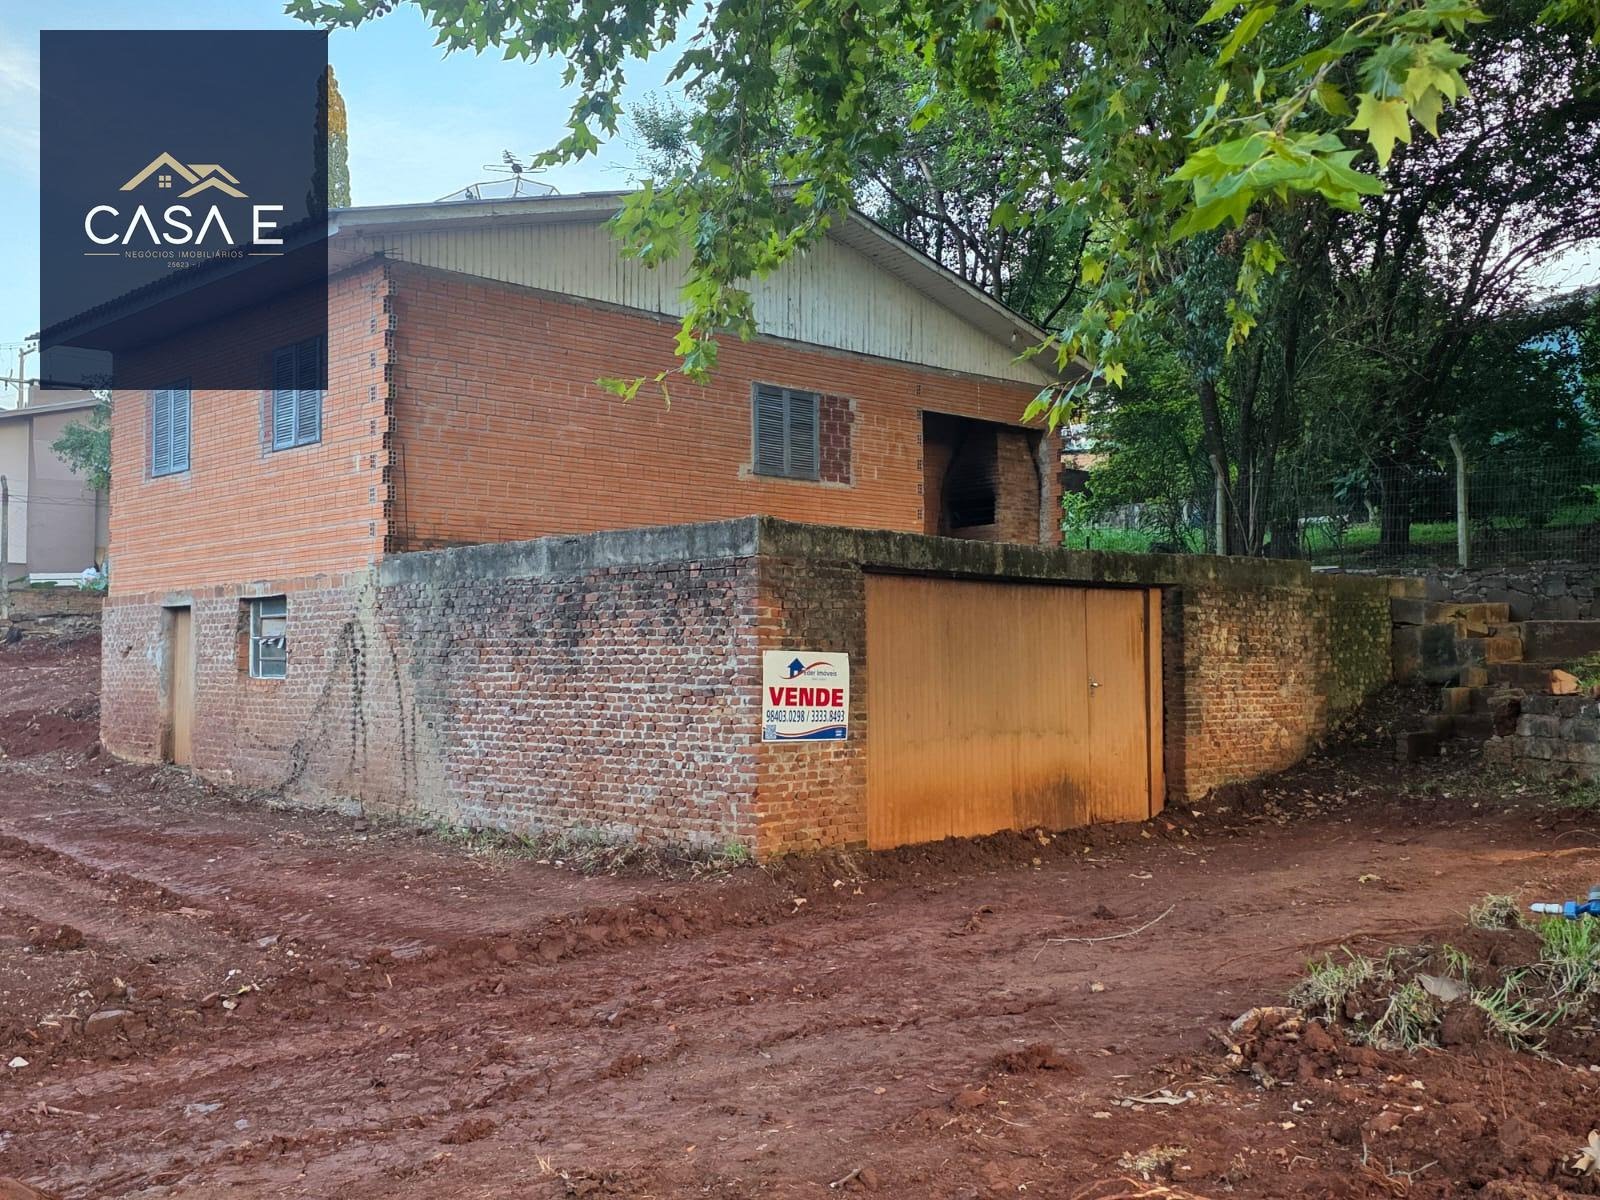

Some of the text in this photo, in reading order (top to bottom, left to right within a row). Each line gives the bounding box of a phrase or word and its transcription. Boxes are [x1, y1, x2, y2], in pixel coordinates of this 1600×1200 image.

[769, 687, 844, 707] VENDE
[766, 710, 805, 723] 98403.0298
[811, 710, 845, 723] 3333.8493
